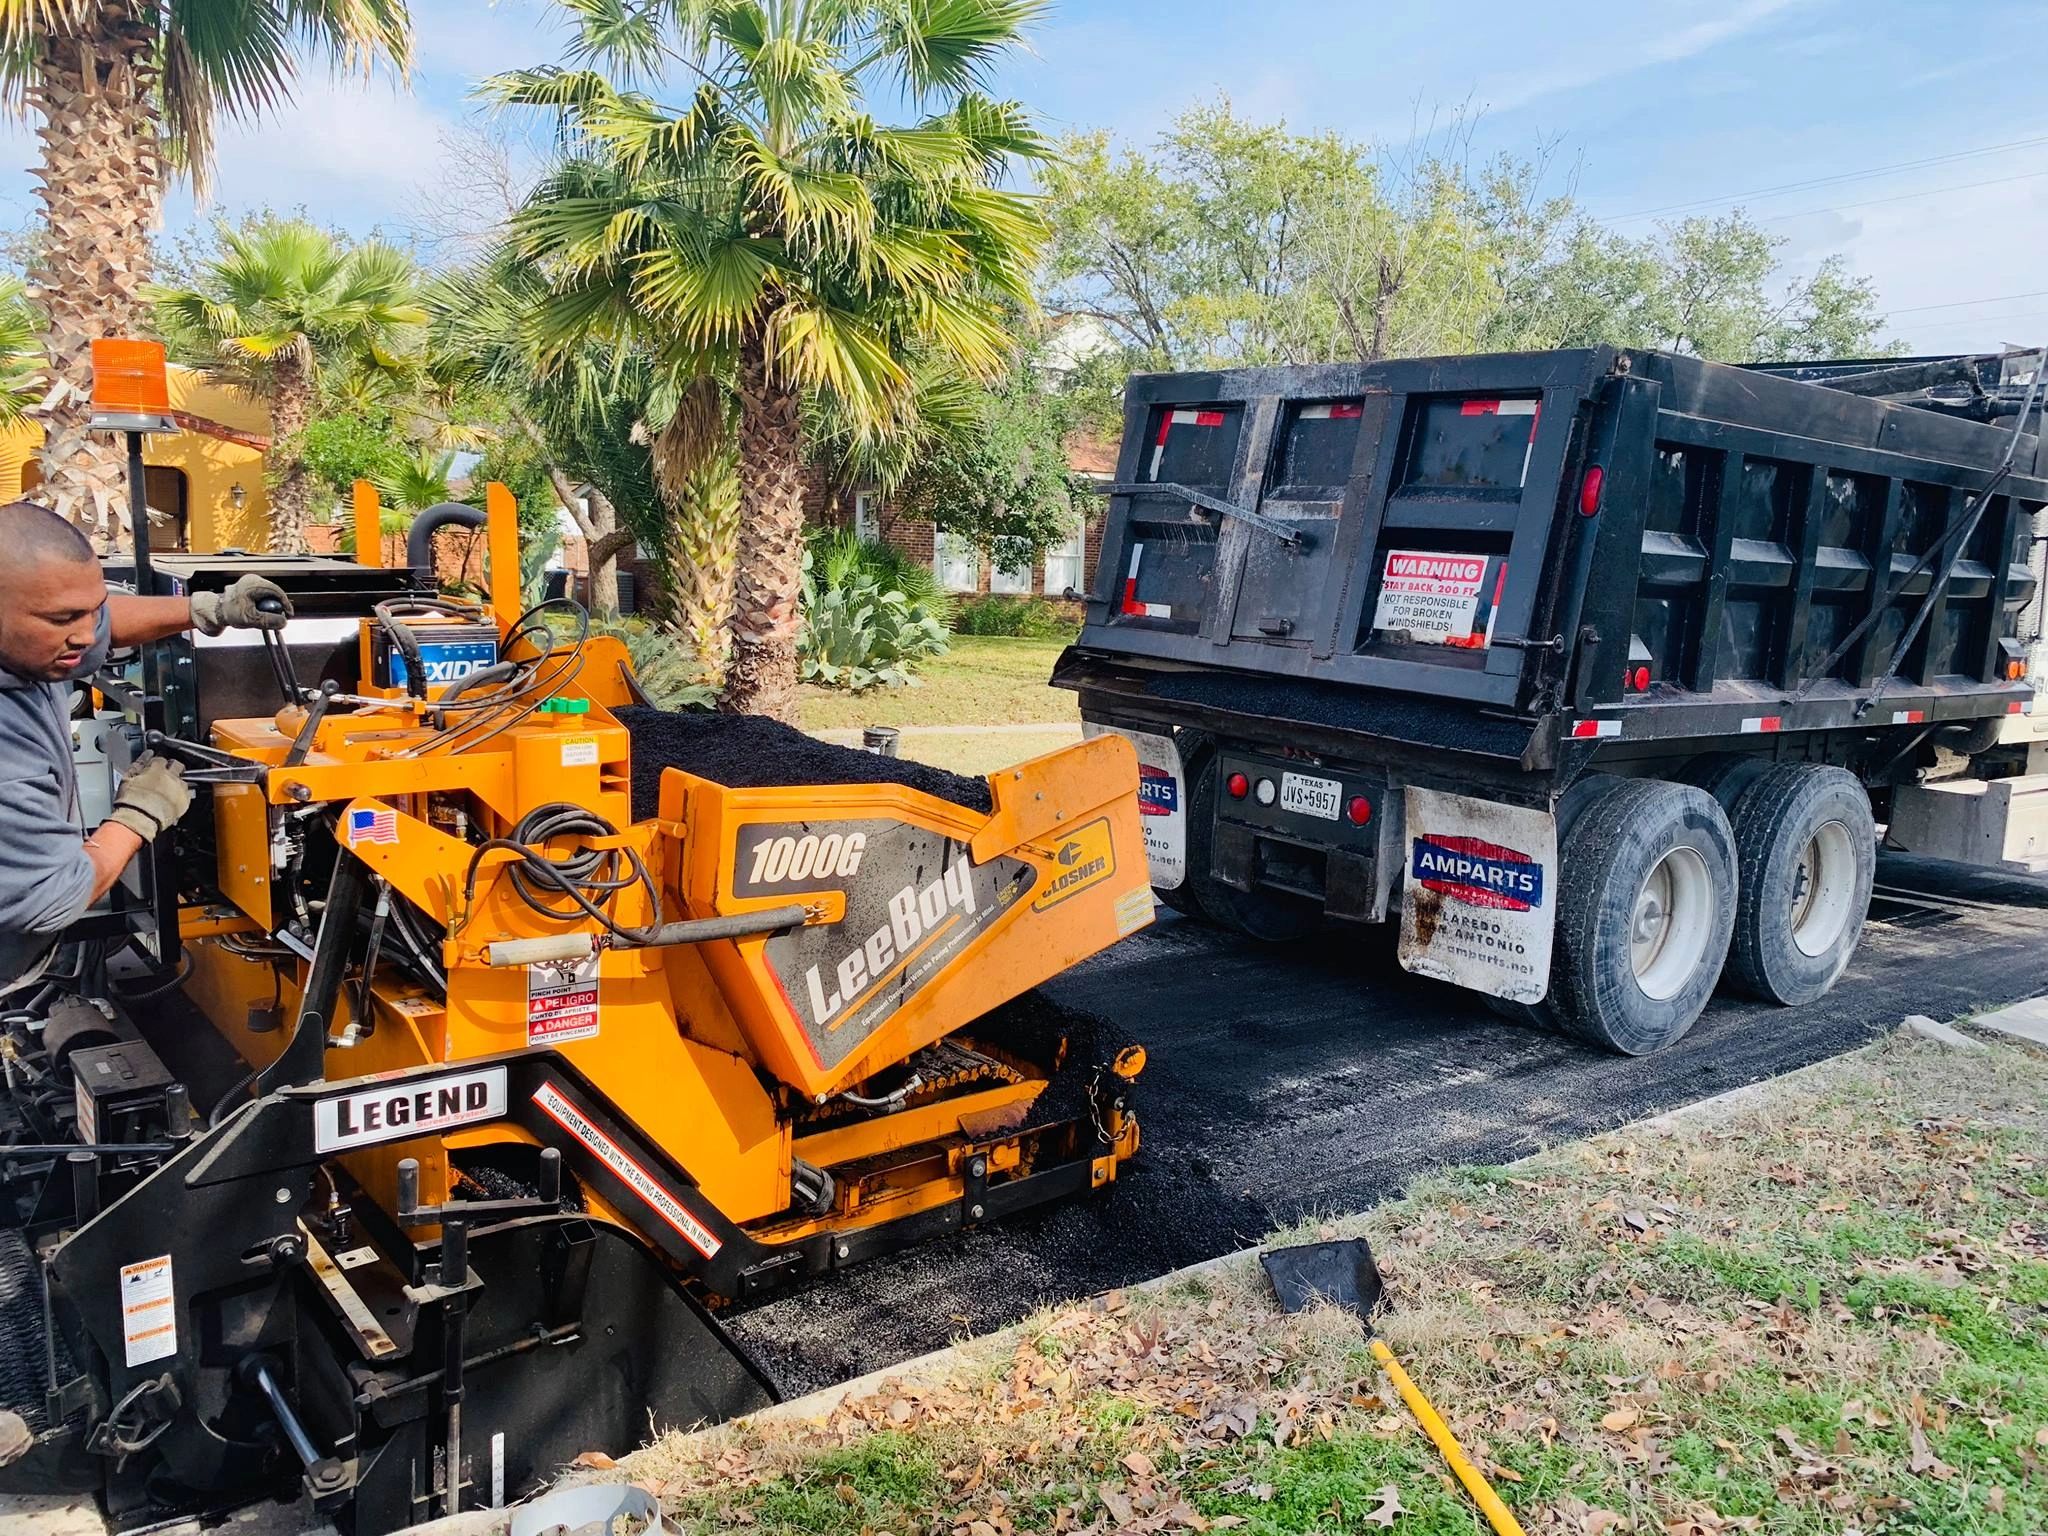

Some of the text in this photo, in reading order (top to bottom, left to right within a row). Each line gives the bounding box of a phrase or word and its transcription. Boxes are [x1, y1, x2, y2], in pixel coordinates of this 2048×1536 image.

[1392, 558, 1479, 580] WARNING
[1384, 581, 1406, 591] STAY
[1408, 582, 1434, 593] BACK
[1437, 584, 1459, 595] 200
[1384, 594, 1469, 610] NOT RESPONSIBLE
[1393, 606, 1453, 620] FOR BROKEN
[1387, 617, 1453, 632] WINDSHIELDS!
[565, 736, 594, 745] CAUTION
[1300, 777, 1324, 789] TEXAS
[749, 832, 867, 884] 1000G
[1420, 853, 1534, 892] AMPARTS
[1442, 911, 1501, 934] LAREDO
[806, 854, 977, 1026] LeeBoy
[1455, 928, 1525, 954] ANTONIO
[861, 1000, 890, 1027] Equipment
[888, 980, 913, 1002] Designed
[911, 968, 924, 982] With
[922, 961, 932, 971] the
[931, 946, 949, 964] Paving
[947, 920, 978, 950] Professional
[531, 987, 572, 998] PINCH POINT
[545, 993, 594, 1010] PELIGRO
[531, 1012, 553, 1021] PUNTO
[563, 1006, 590, 1016] APRIETE
[545, 1014, 593, 1032] DANGER
[531, 1034, 549, 1042] POINT
[559, 1026, 594, 1037] PINCEMENT
[338, 1081, 488, 1138] LEGEND
[416, 1108, 489, 1128] Screed System
[580, 1124, 610, 1156] DESIGNED
[608, 1150, 625, 1170] WITH
[623, 1162, 636, 1180] THE
[633, 1172, 655, 1197] PAVING
[652, 1190, 690, 1232] PROFESSIONAL
[690, 1224, 698, 1237] IN
[132, 1259, 168, 1273] WARNING
